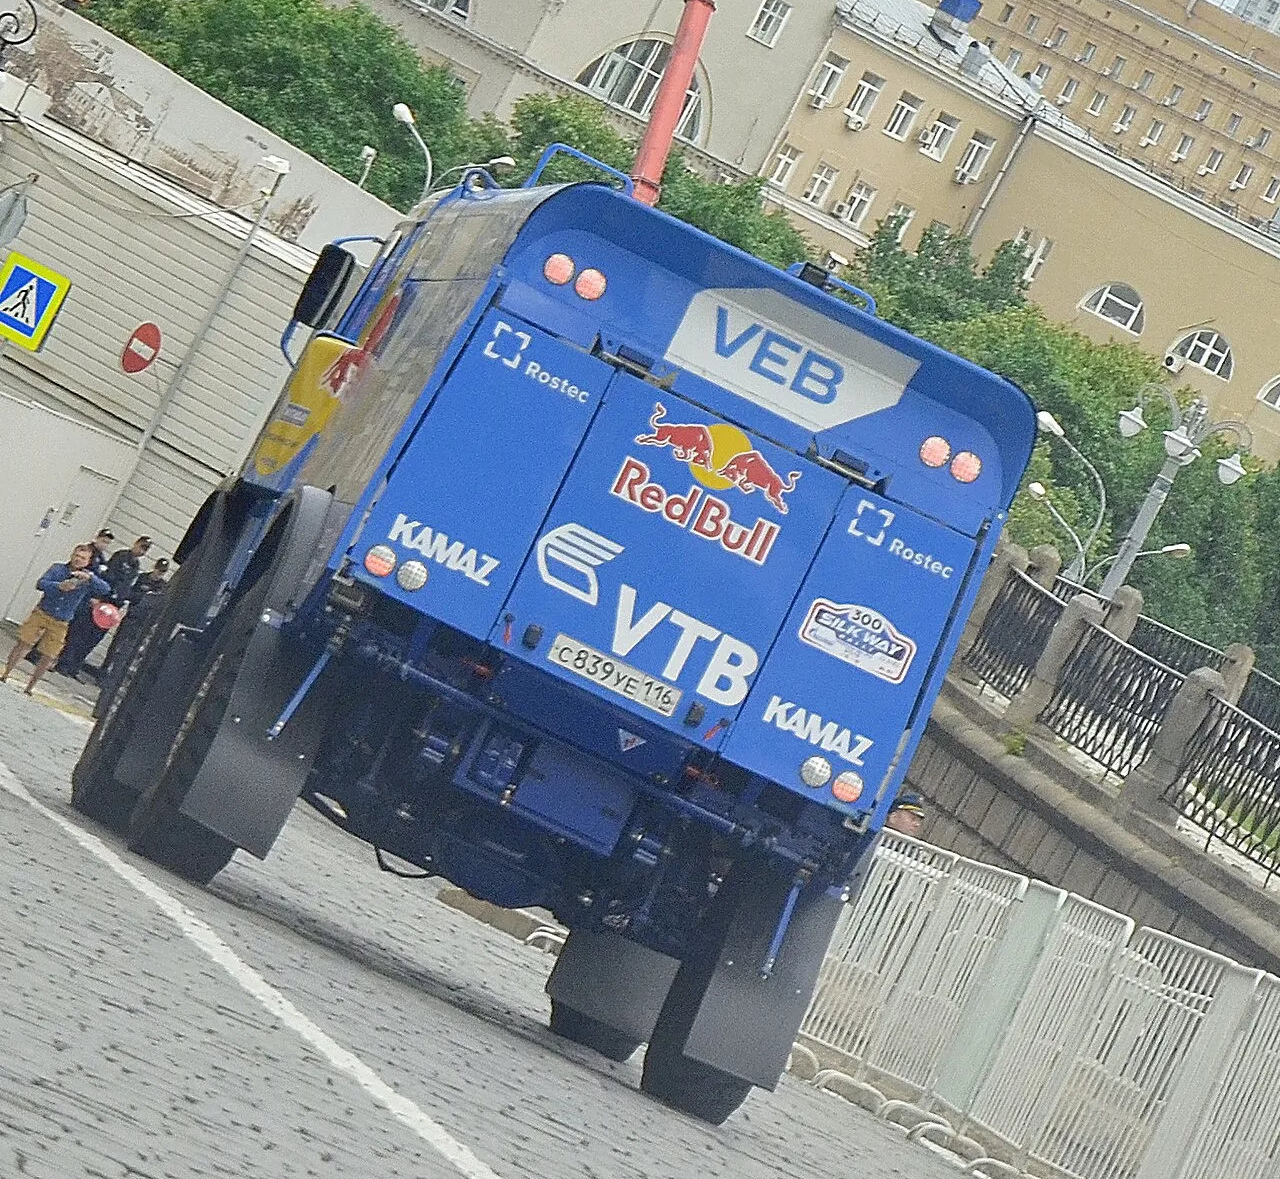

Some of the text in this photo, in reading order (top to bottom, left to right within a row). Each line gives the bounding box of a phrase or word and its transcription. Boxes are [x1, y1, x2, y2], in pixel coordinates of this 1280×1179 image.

[525, 361, 589, 403] Rostec
[715, 307, 844, 405] VEB
[609, 454, 782, 567] Red Bull
[387, 512, 502, 588] KAMAZ
[889, 538, 953, 579] Rostec
[611, 583, 760, 707] VTB
[818, 612, 864, 634] SILK
[862, 628, 904, 656] WAY
[852, 608, 882, 630] 300
[761, 694, 875, 768] KAMAZ
